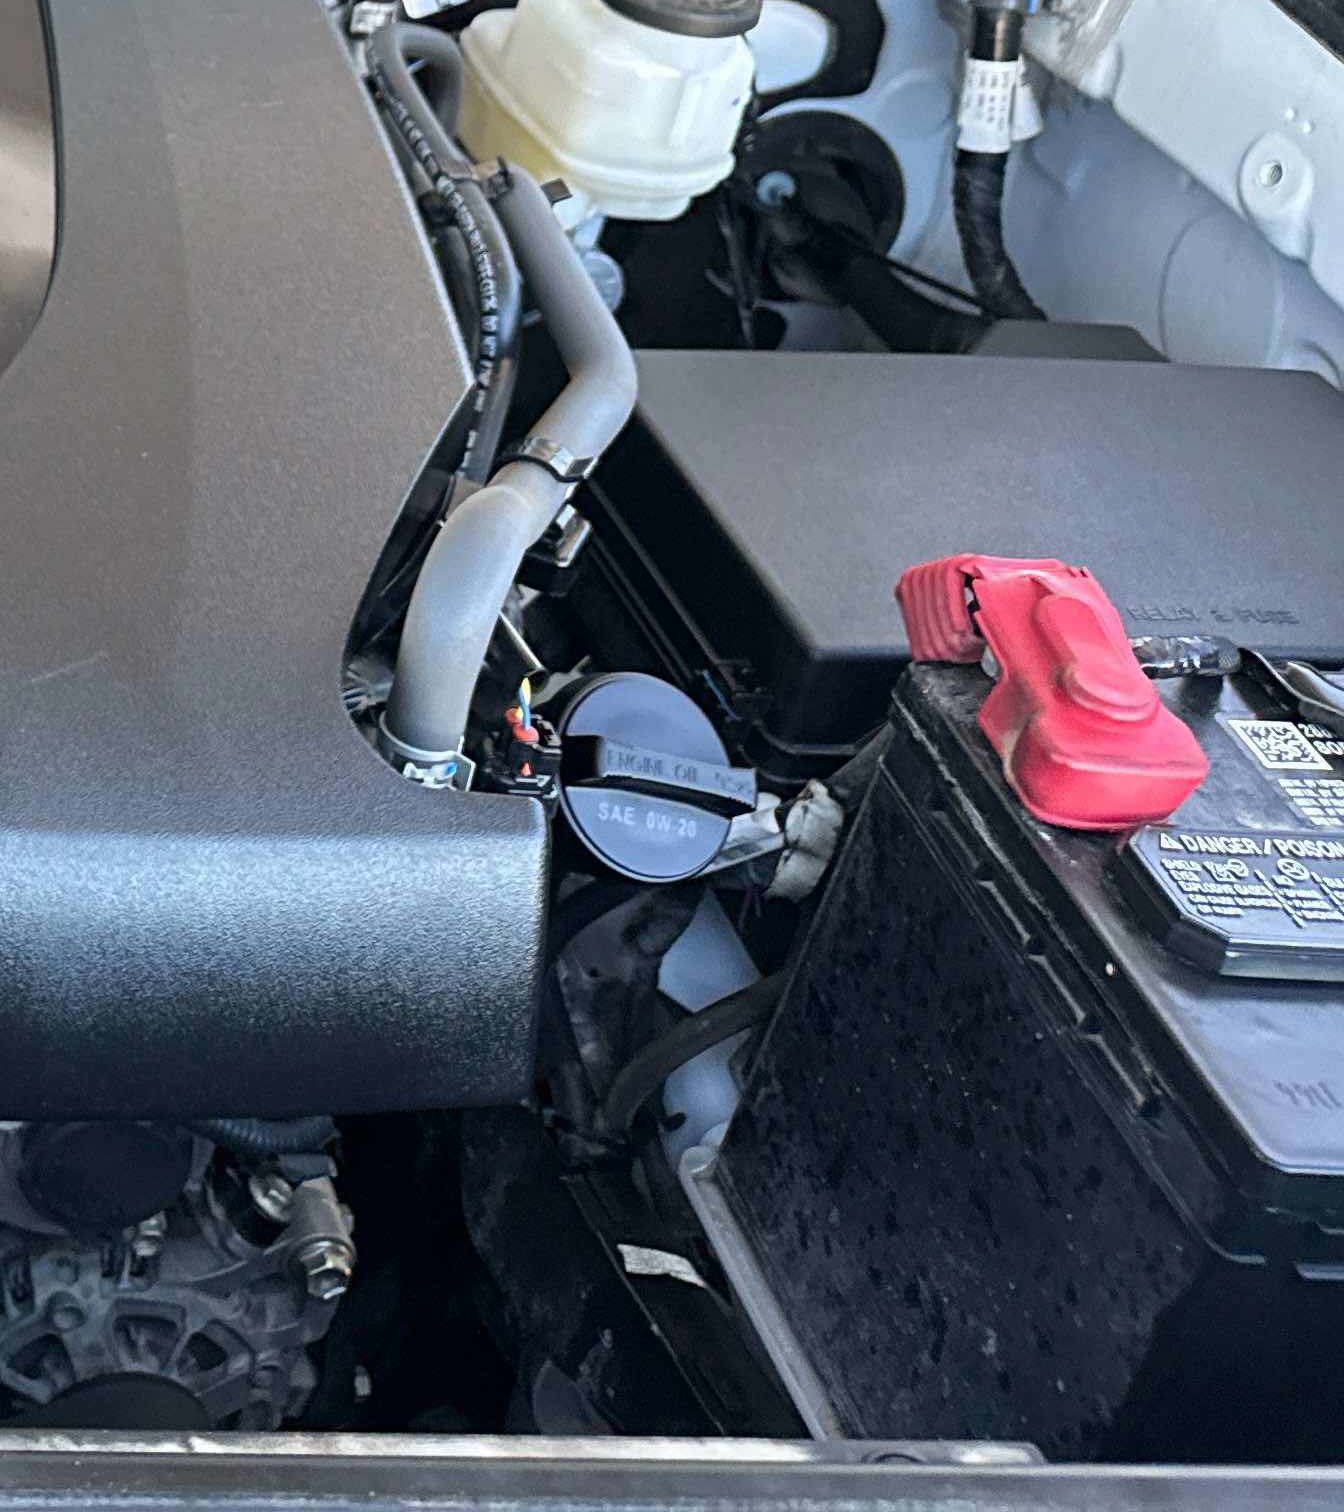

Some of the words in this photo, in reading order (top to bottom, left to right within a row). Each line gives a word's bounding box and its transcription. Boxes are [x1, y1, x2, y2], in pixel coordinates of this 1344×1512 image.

[606, 749, 663, 778] ENGINE
[598, 802, 636, 826] SAE
[645, 811, 698, 839] 0W-20
[1179, 834, 1263, 855] DANGER
[1272, 838, 1344, 858] POISON
